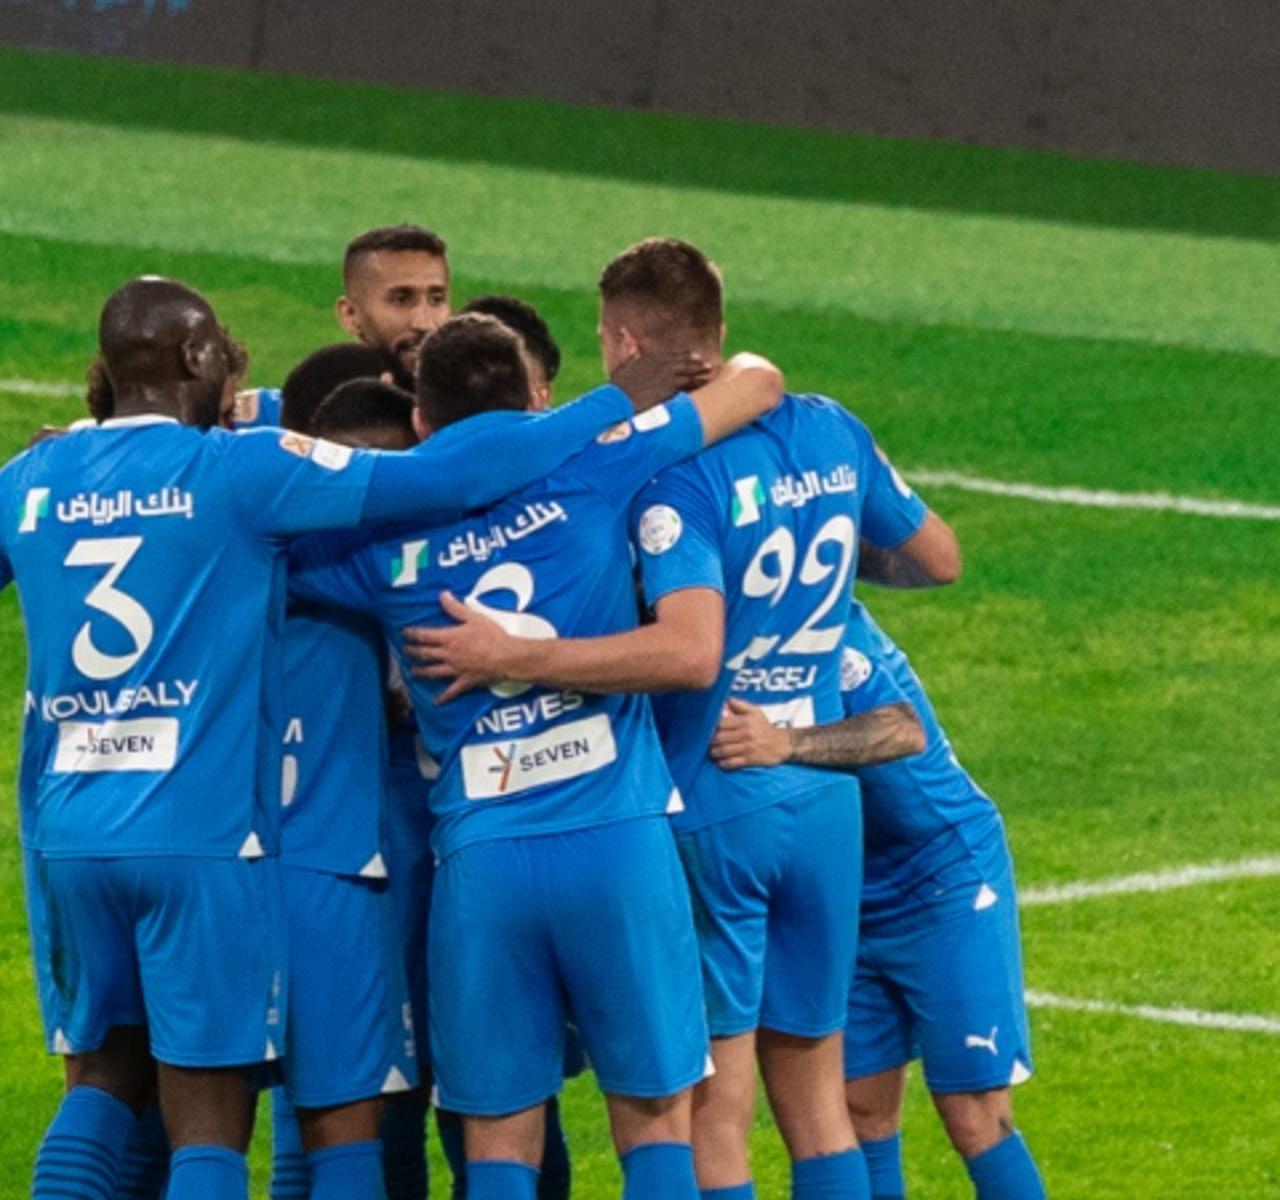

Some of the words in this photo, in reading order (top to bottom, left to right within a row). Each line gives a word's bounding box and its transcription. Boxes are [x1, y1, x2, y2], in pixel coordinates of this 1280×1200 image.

[56, 489, 133, 527] الرياض
[135, 486, 194, 519] بنك
[503, 500, 568, 541] بنك
[63, 535, 154, 679] 3
[725, 513, 856, 670] 22
[475, 690, 583, 735] NEVES
[519, 738, 590, 773] SEVEN
